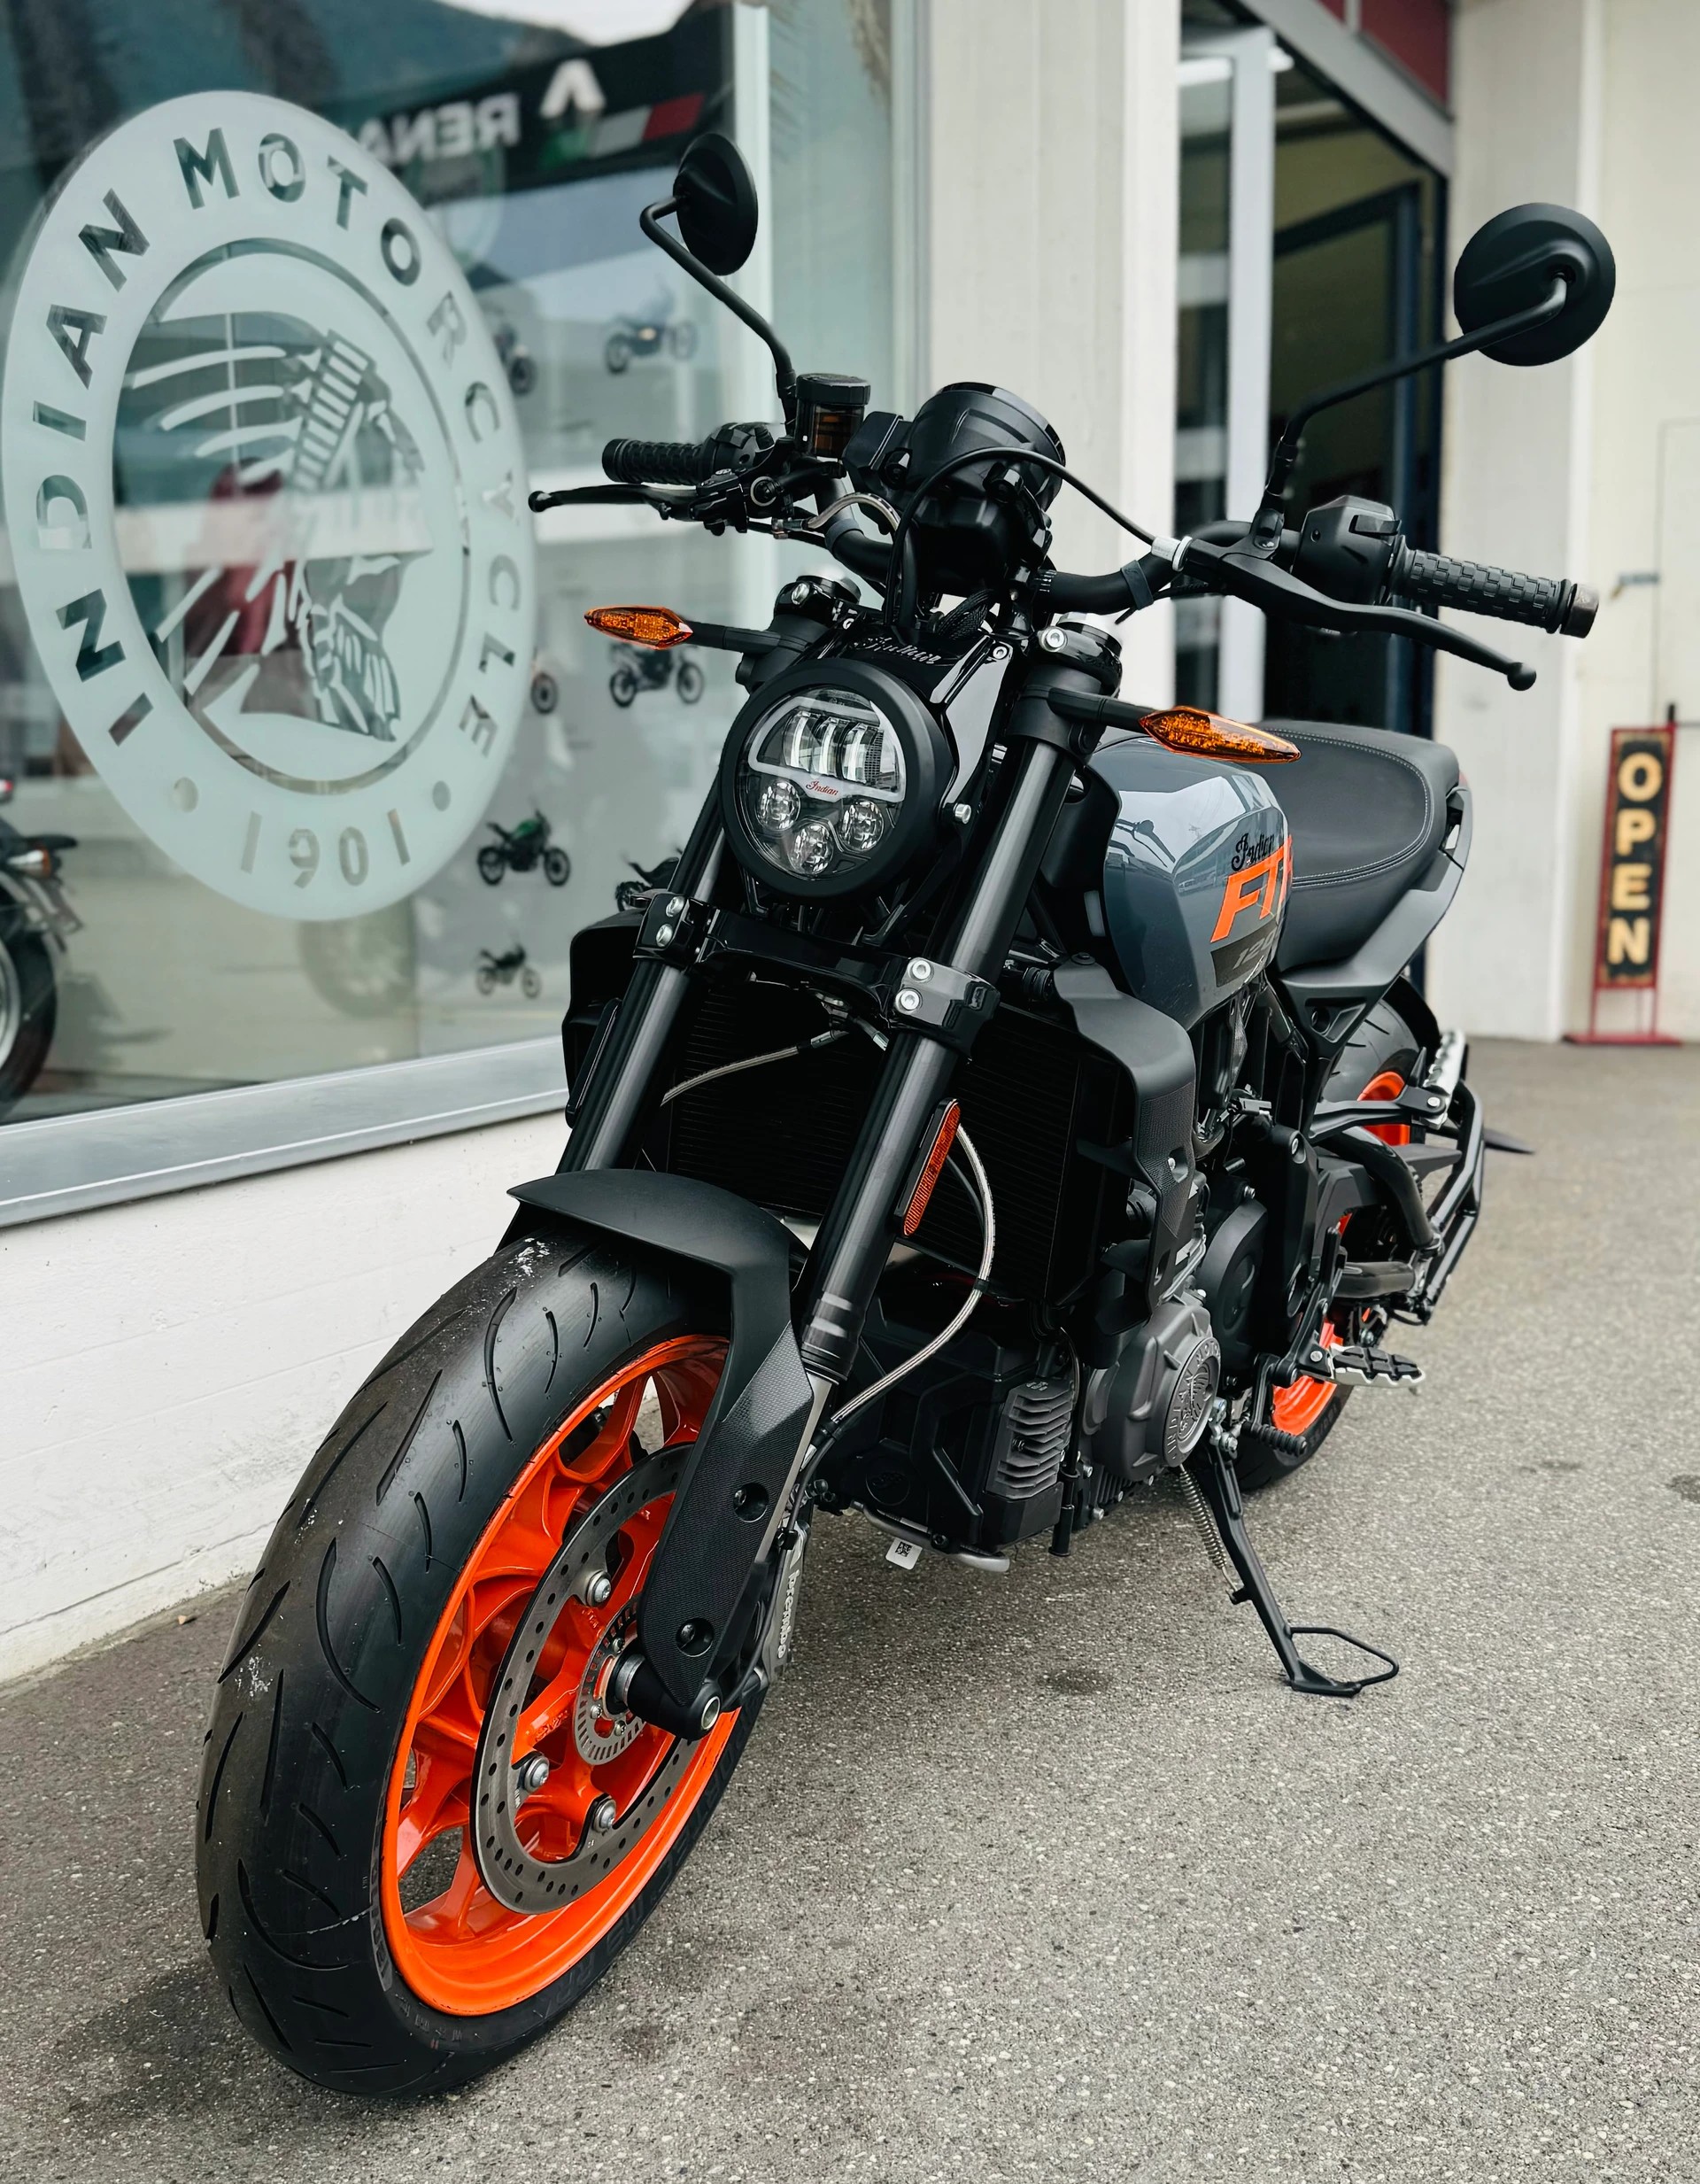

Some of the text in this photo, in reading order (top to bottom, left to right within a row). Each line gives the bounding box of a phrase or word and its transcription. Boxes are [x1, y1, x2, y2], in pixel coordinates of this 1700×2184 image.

[32, 128, 521, 758] INDIAN MOTORCYCLE
[805, 780, 838, 795] Indian
[240, 808, 411, 889] 1901
[1231, 833, 1275, 872] Indian
[1607, 752, 1663, 964] OPEN
[1232, 926, 1279, 971] 120
[777, 1569, 800, 1660] brembo
